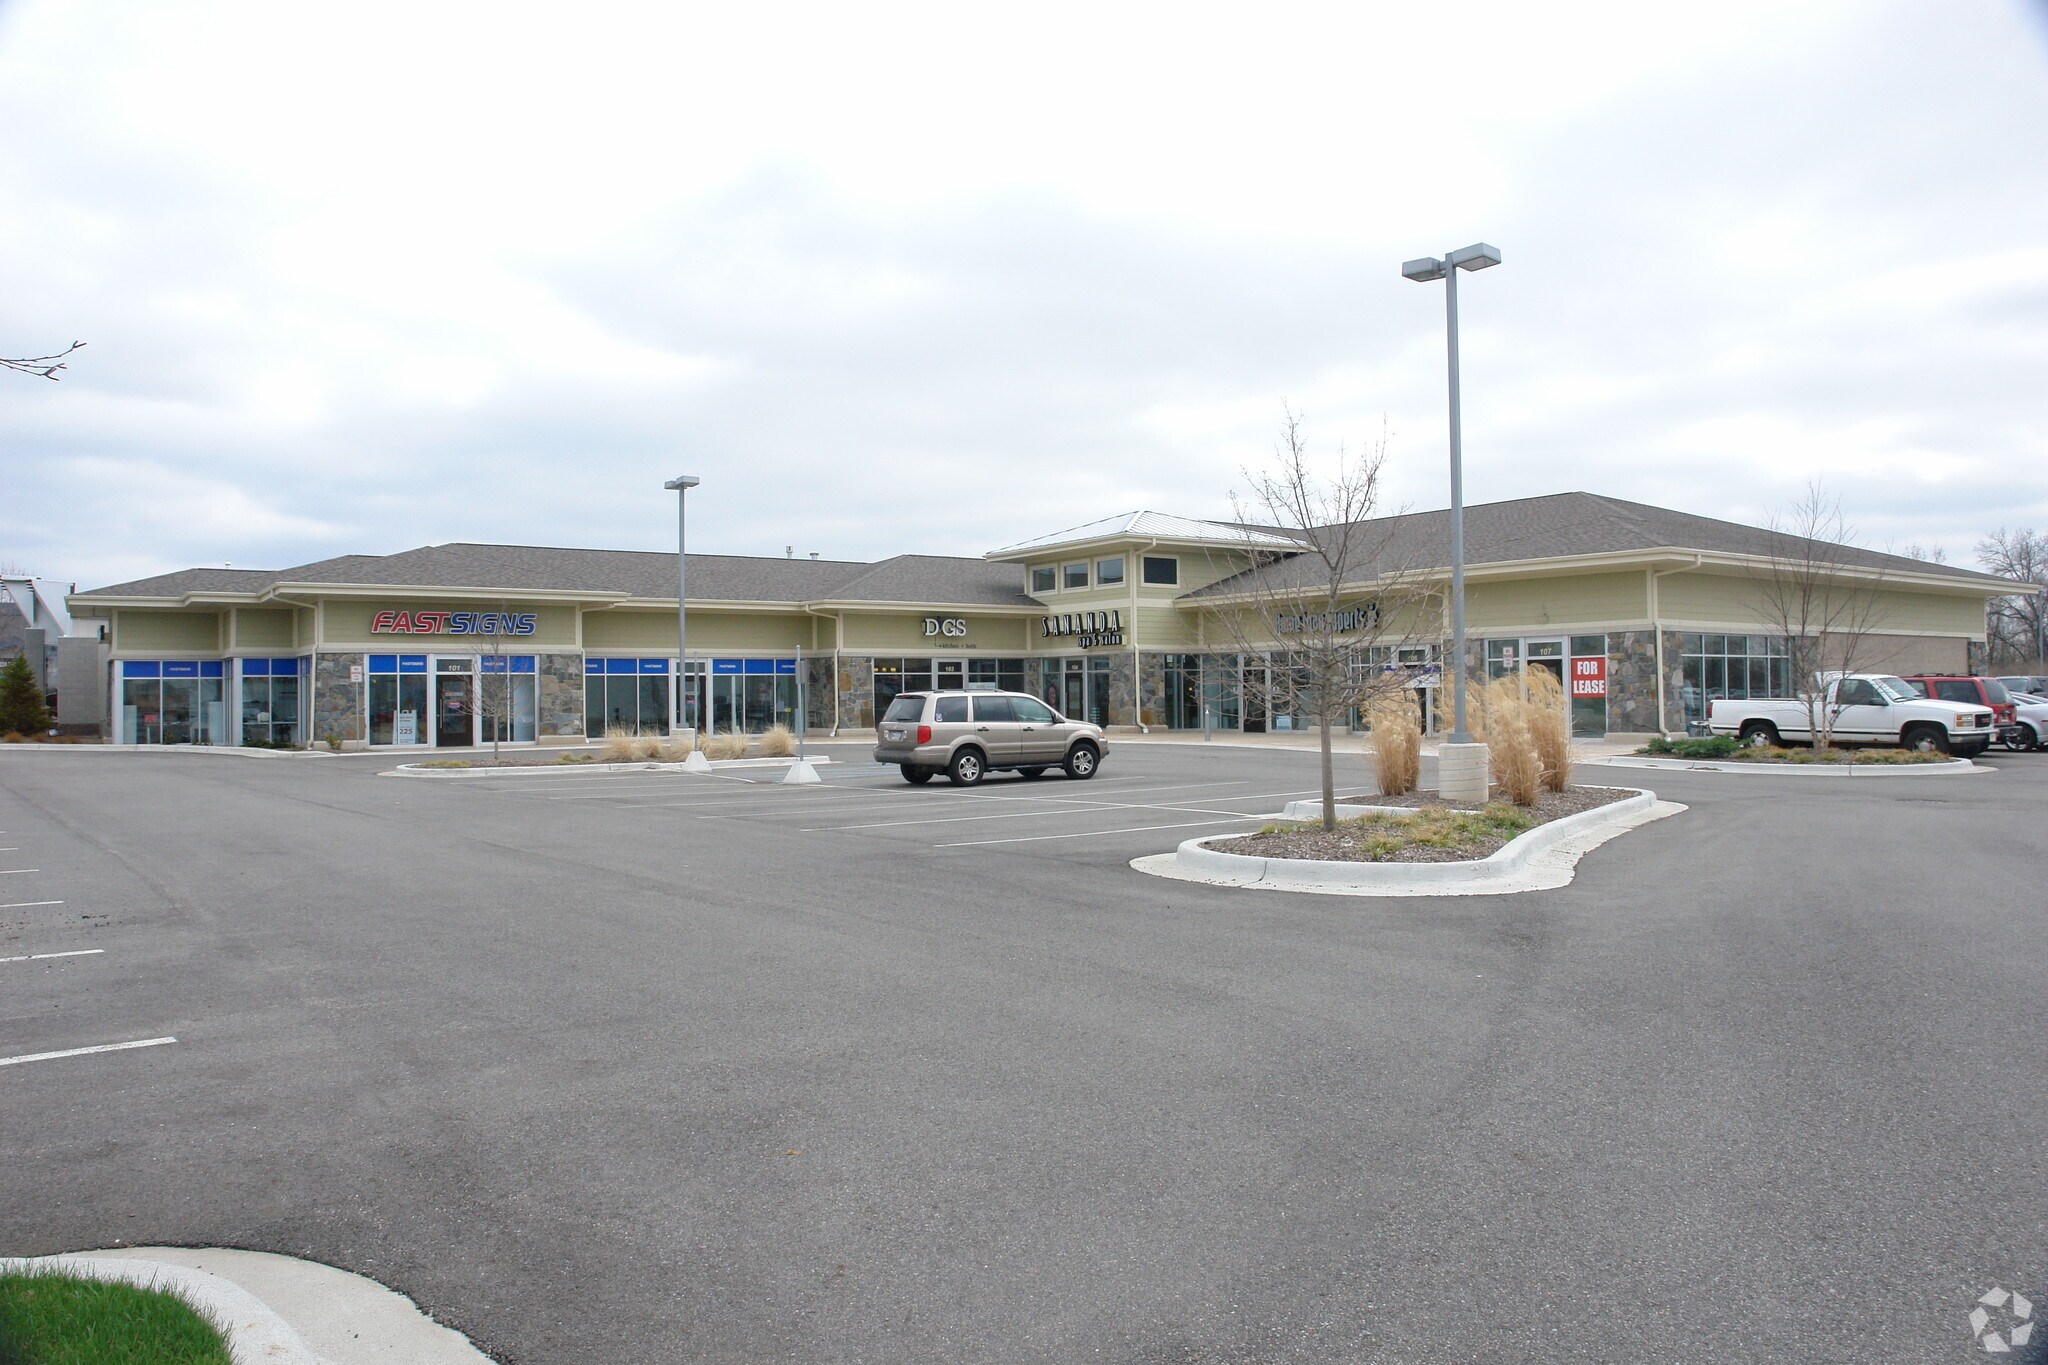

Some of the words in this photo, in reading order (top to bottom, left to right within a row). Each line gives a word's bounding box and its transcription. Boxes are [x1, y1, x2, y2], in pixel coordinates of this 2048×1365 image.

[371, 610, 537, 635] FASTSIGNS
[1041, 610, 1120, 637] SANANDA
[1078, 636, 1090, 649] spa
[1092, 633, 1098, 646] &
[1099, 632, 1121, 646] salon
[448, 664, 461, 672] 101
[1577, 661, 1598, 675] FOR
[1573, 680, 1605, 694] LEASE
